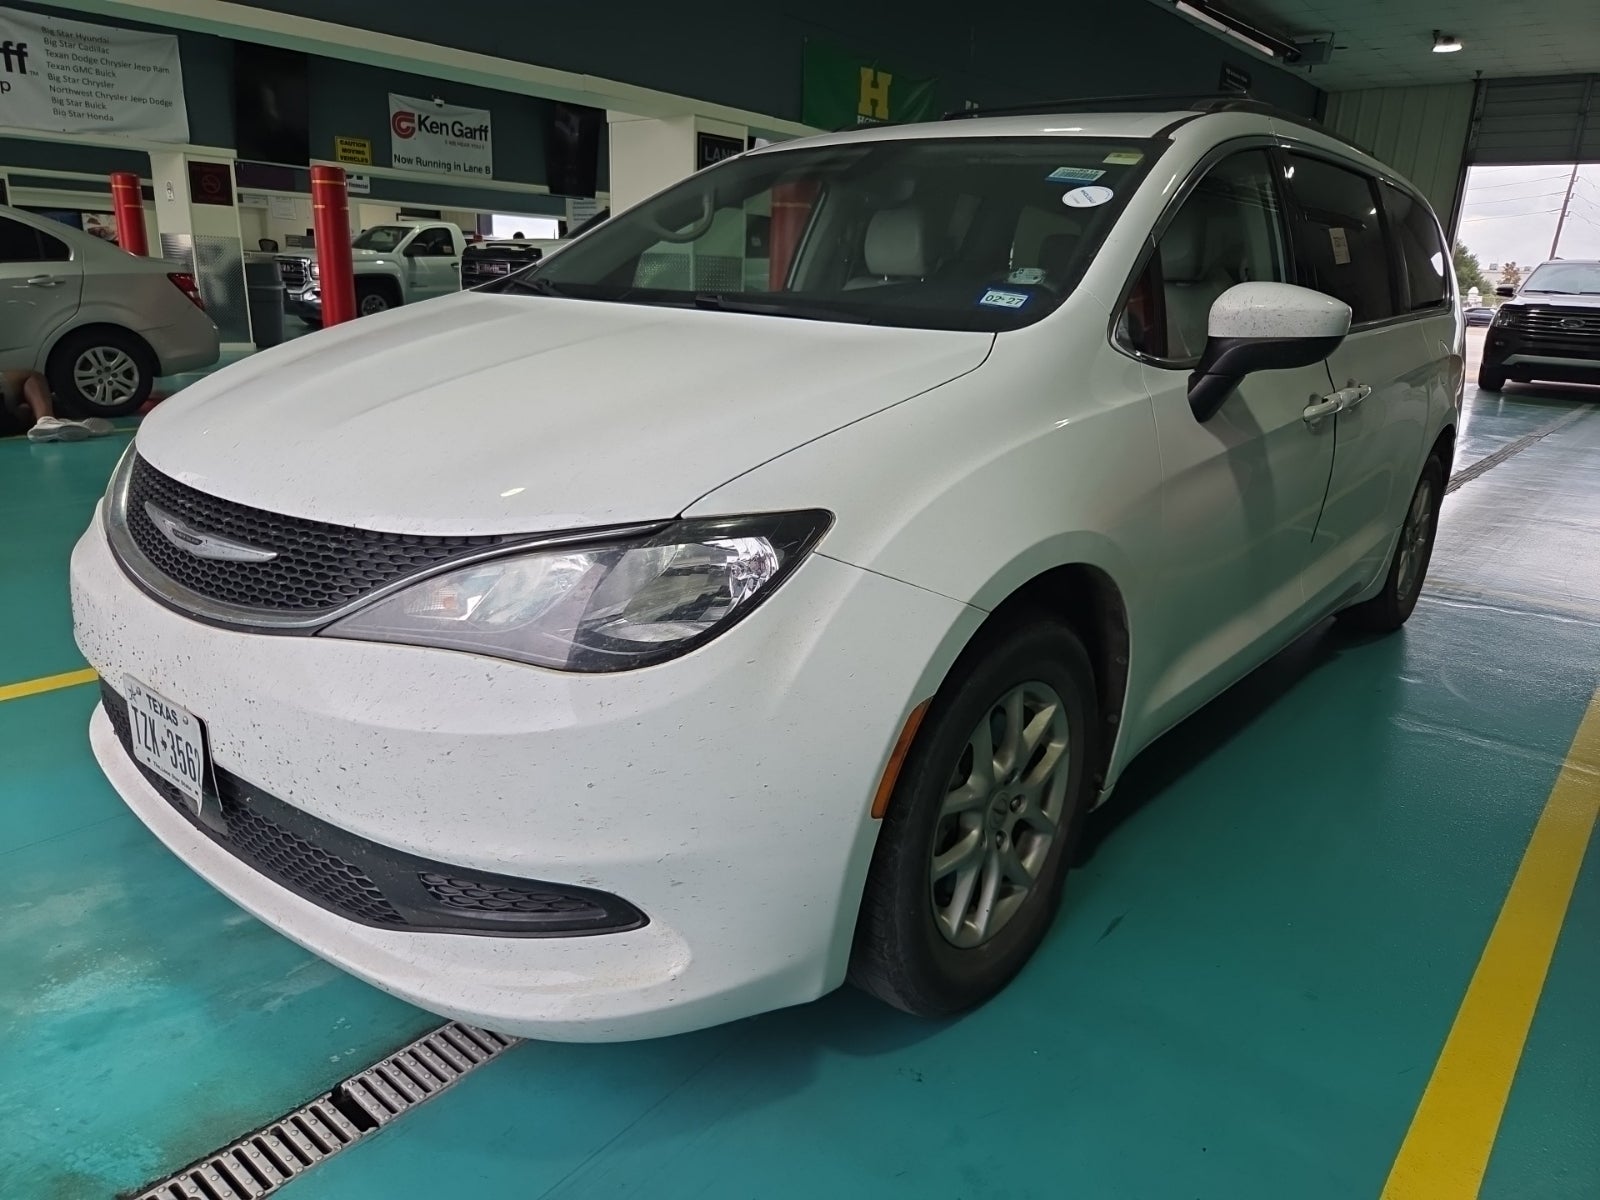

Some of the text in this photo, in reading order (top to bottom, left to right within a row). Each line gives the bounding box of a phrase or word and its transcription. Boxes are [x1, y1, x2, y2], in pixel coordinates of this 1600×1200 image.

[56, 28, 73, 39] Star
[76, 33, 110, 44] Hyundai
[43, 37, 110, 55] Big Star Cadillac
[45, 49, 170, 74] Texan Dodge Chrysler Jeep Ram
[46, 61, 117, 78] Texan GMC Buick
[48, 73, 115, 89] Big Star Chrysler
[49, 85, 174, 108] Northwest Chrysler Jeep Dodge
[858, 66, 893, 120] H
[51, 96, 107, 110] Big Star Buick
[68, 109, 85, 119] Star
[87, 111, 114, 122] Honda
[417, 114, 489, 142] Ken Garff
[339, 139, 366, 148] CAUTION
[339, 155, 369, 163] VEHICLES
[393, 153, 491, 175] Now Running in Lane B
[985, 294, 1024, 305] 02 27
[146, 693, 178, 727] TEXAS
[131, 705, 160, 758] TZK
